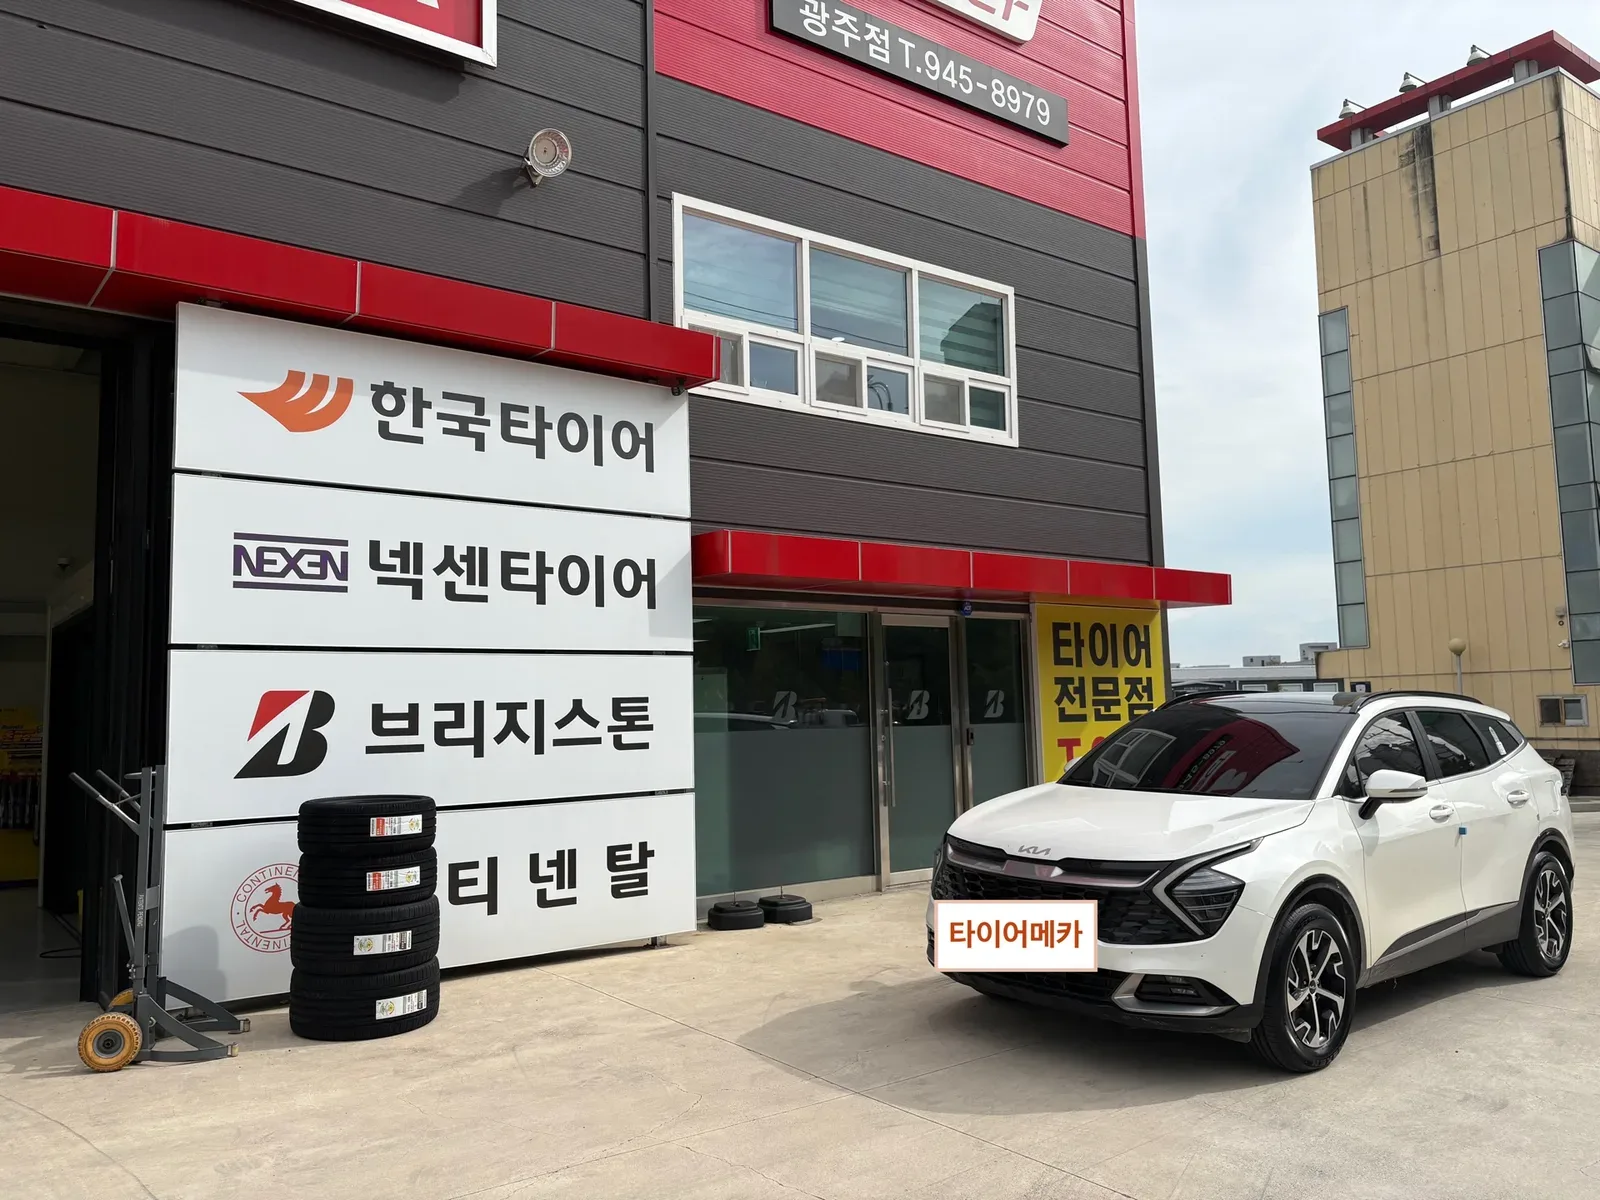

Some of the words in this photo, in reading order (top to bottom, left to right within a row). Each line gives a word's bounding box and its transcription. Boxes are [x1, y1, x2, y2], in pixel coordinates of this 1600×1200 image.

[799, 0, 891, 64] 광주점
[898, 37, 1051, 126] T.945-8979
[370, 381, 654, 473] 한국타이어
[233, 544, 348, 581] NEXEN
[369, 540, 656, 610] 넥센타이어
[1052, 622, 1152, 668] 타이어
[1054, 677, 1154, 722] 전문점
[365, 696, 654, 759] 브리지스톤
[236, 866, 299, 903] CONTINE
[236, 920, 291, 950] INENTAL
